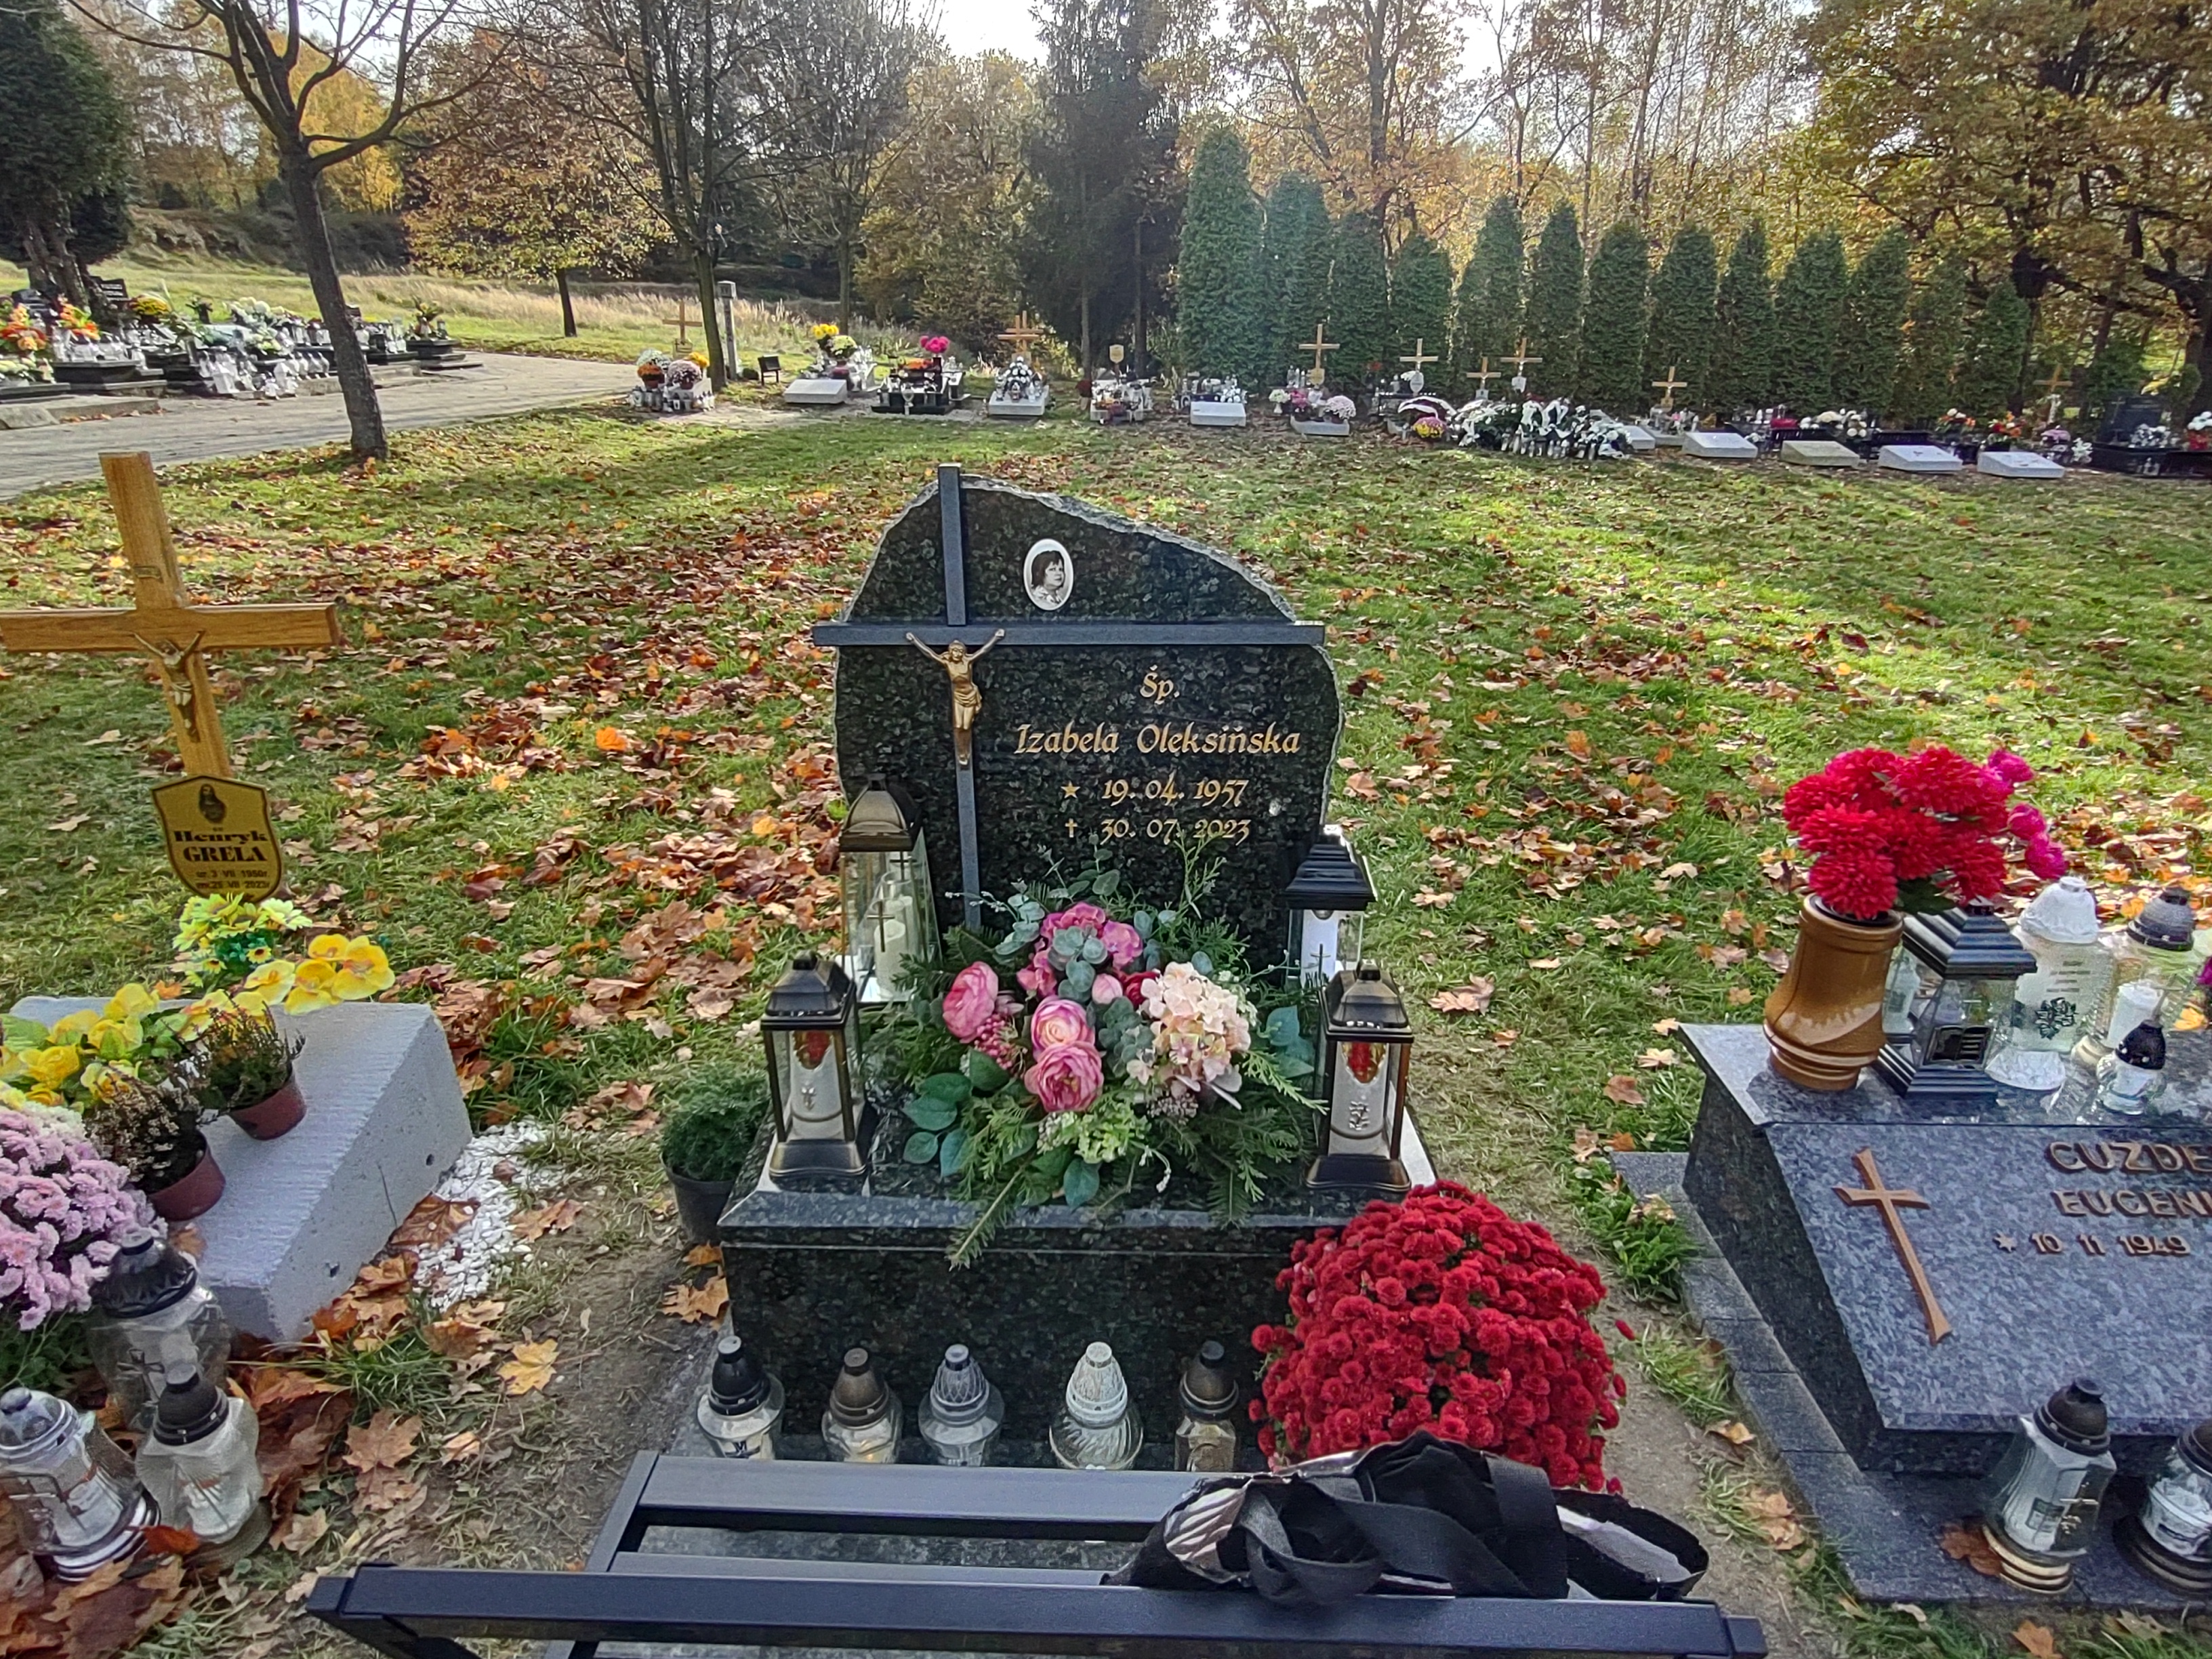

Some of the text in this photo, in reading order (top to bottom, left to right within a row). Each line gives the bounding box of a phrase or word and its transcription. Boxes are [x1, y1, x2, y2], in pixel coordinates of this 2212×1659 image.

[1140, 664, 1180, 705] Śp.
[1014, 720, 1301, 754] Izabela Oleksińska
[1101, 769, 1250, 807] 19. 04. 1957
[173, 830, 268, 844] Henryk
[1100, 818, 1136, 846] 30.
[1193, 818, 1252, 846] 2023
[183, 846, 268, 862] GRELA
[2029, 1231, 2064, 1255] 10
[2076, 1233, 2106, 1256] 11
